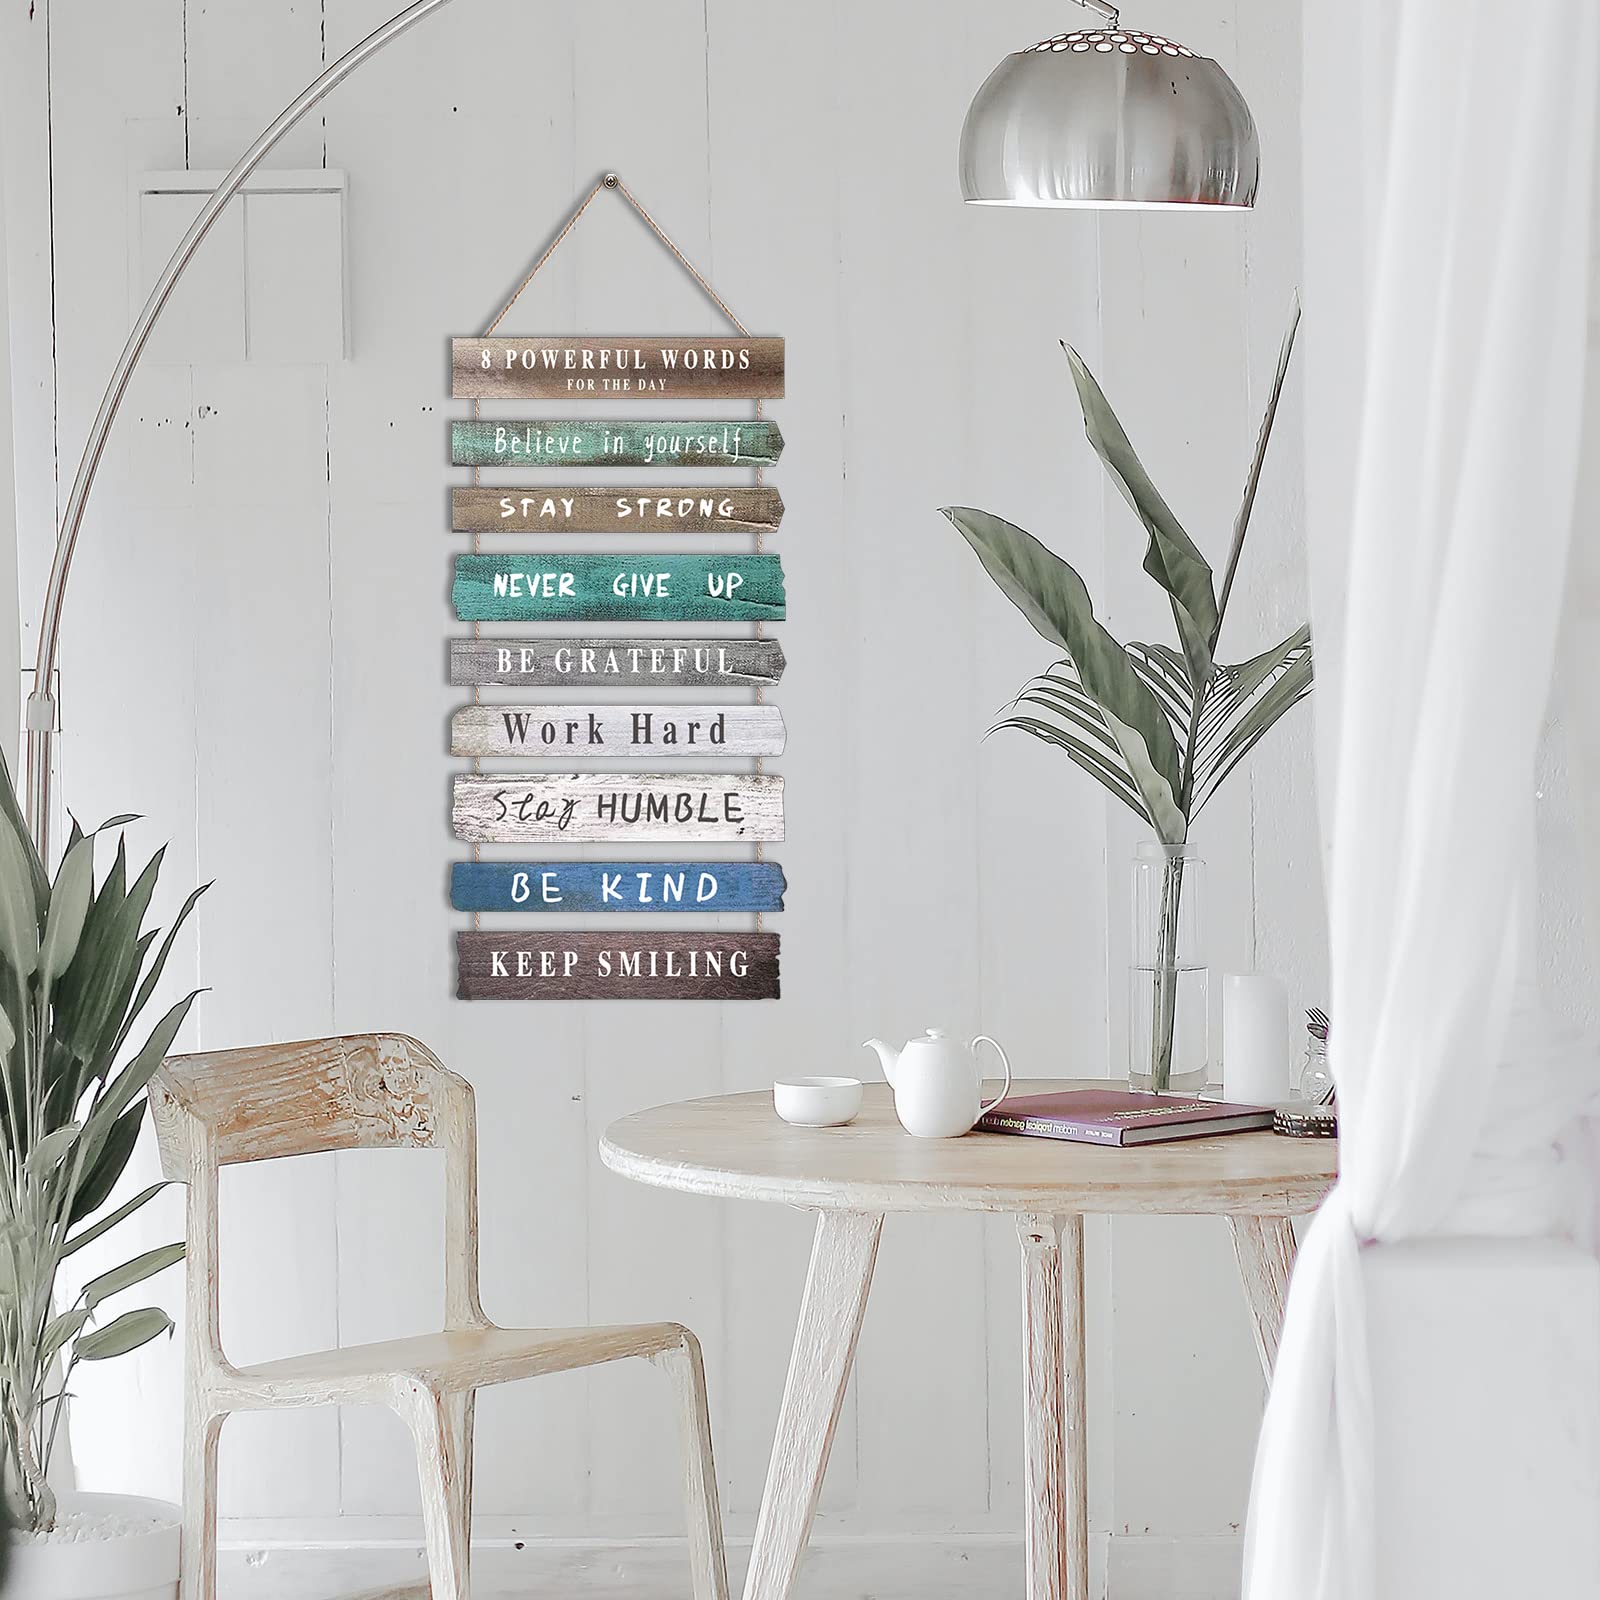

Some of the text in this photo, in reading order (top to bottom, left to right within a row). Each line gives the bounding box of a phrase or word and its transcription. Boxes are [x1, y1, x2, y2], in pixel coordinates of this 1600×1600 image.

[480, 348, 750, 370] 8 POWERFUL WORDS
[567, 378, 667, 391] FOR THE DAY
[494, 427, 742, 463] Believe in yourself
[499, 497, 735, 518] STAY STRONG
[493, 572, 744, 599] NEVER GIVE UP
[496, 648, 734, 673] BE GRATEFUL
[501, 713, 727, 745] Work Hard
[492, 789, 745, 831] Stay HUMBLE
[511, 872, 719, 903] BE KIND
[490, 950, 750, 978] KEEP SMILING
